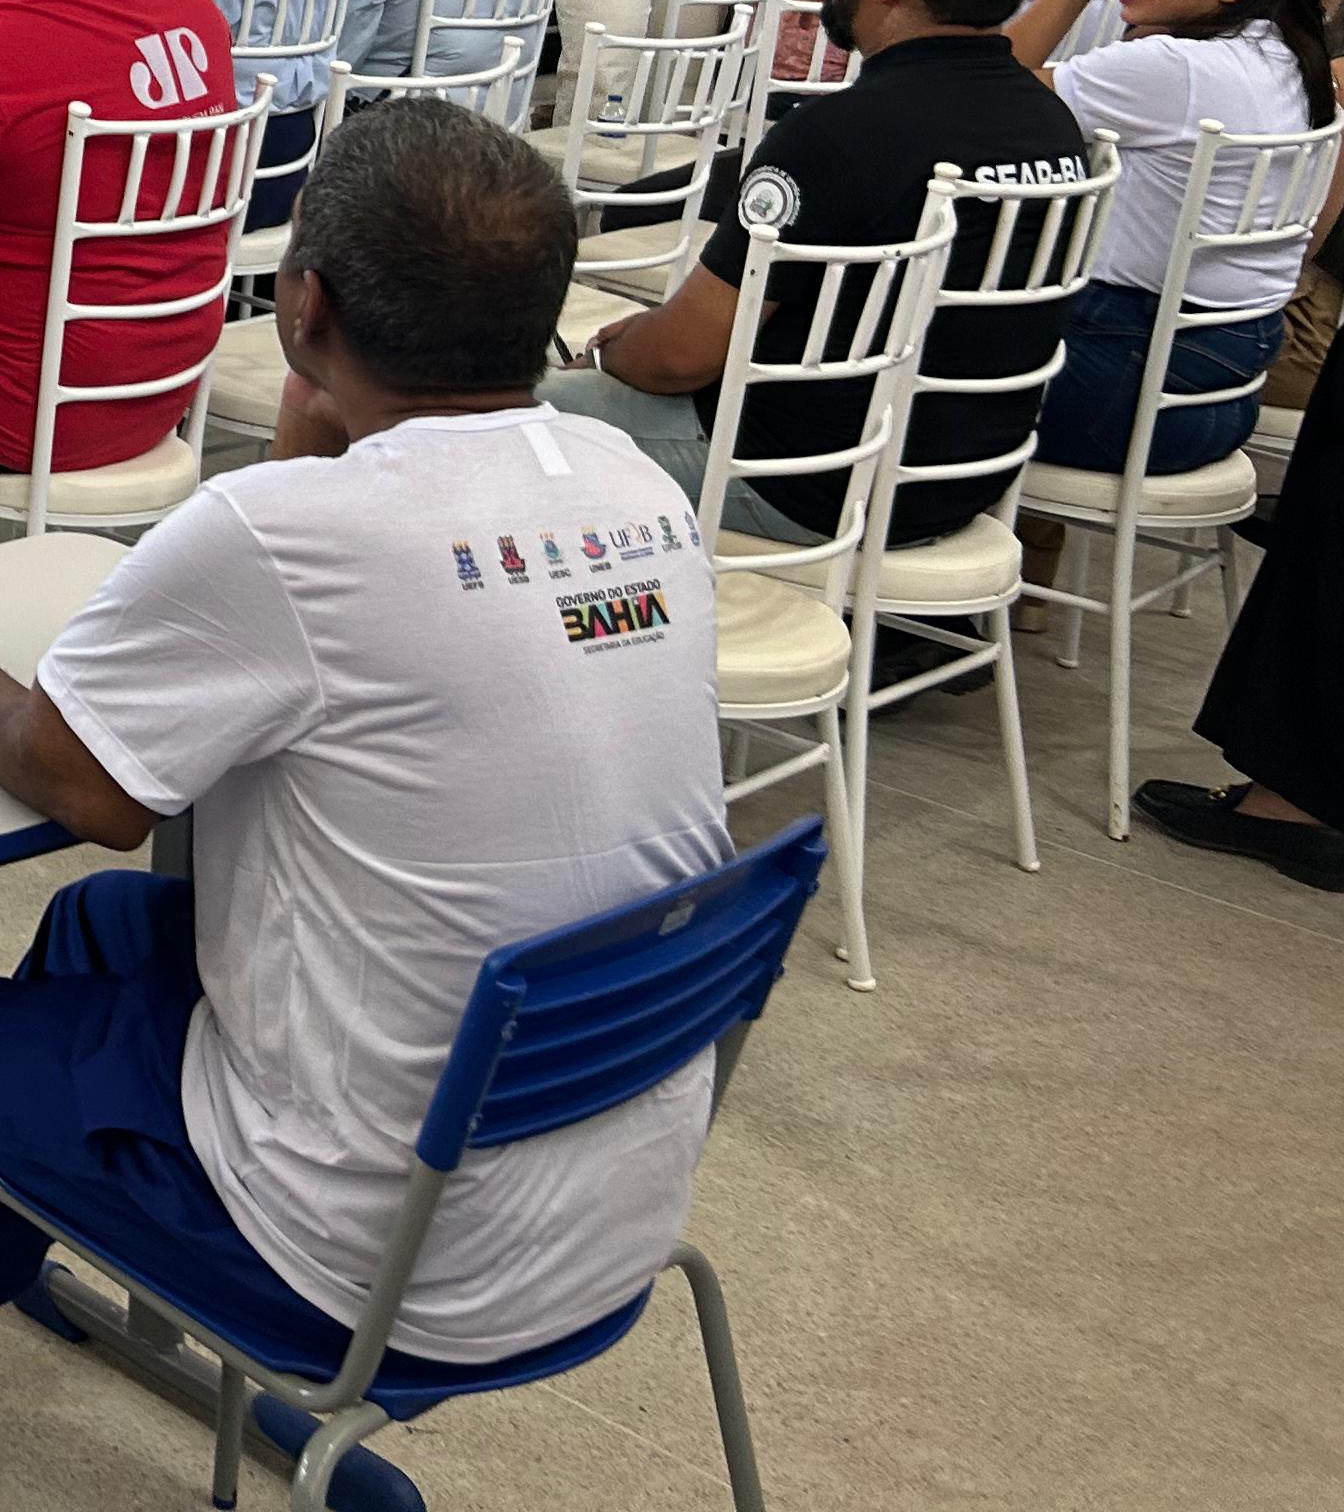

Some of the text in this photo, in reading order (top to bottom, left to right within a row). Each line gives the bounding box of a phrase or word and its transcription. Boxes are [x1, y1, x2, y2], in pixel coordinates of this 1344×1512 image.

[556, 579, 661, 608] GOVERNO DO ESTADO
[559, 592, 671, 643] BAHIA
